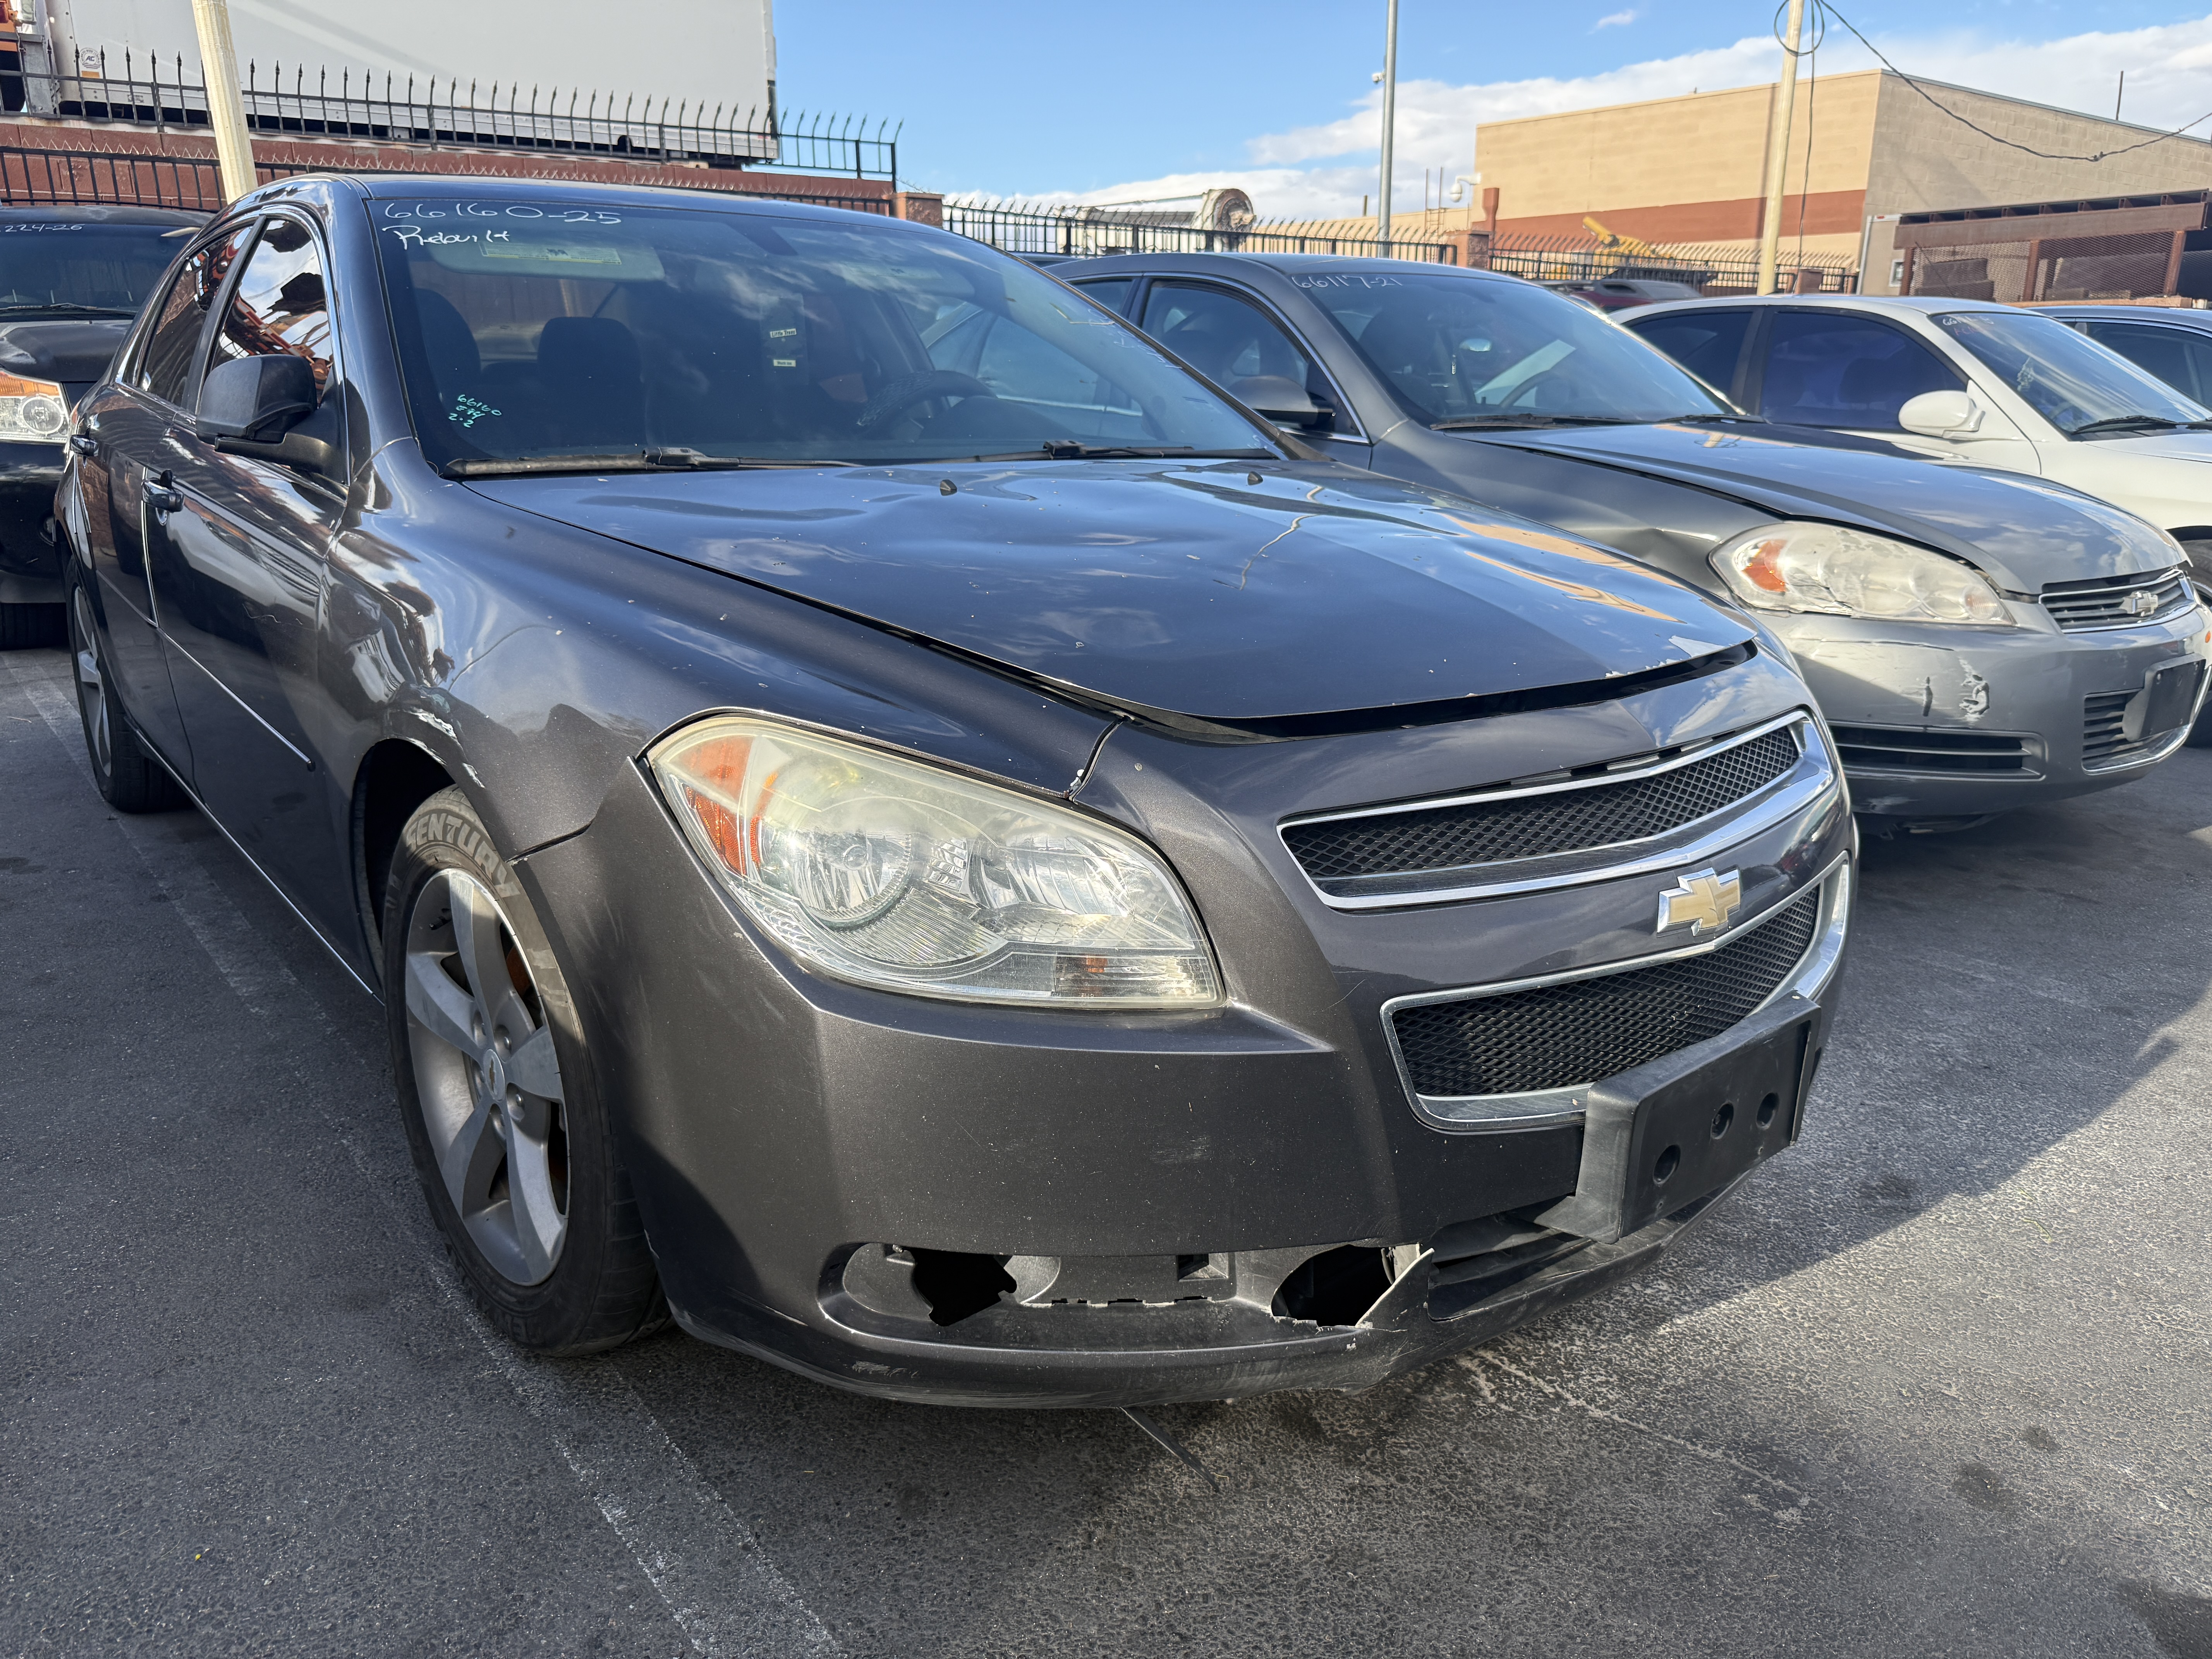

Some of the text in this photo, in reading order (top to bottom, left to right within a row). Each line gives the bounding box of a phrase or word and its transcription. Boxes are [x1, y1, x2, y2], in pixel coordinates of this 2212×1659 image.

[385, 203, 622, 224] 66160-25
[0, 224, 85, 232] 224-26
[1291, 275, 1403, 289] 66117-21
[406, 813, 521, 898] SENTURY
